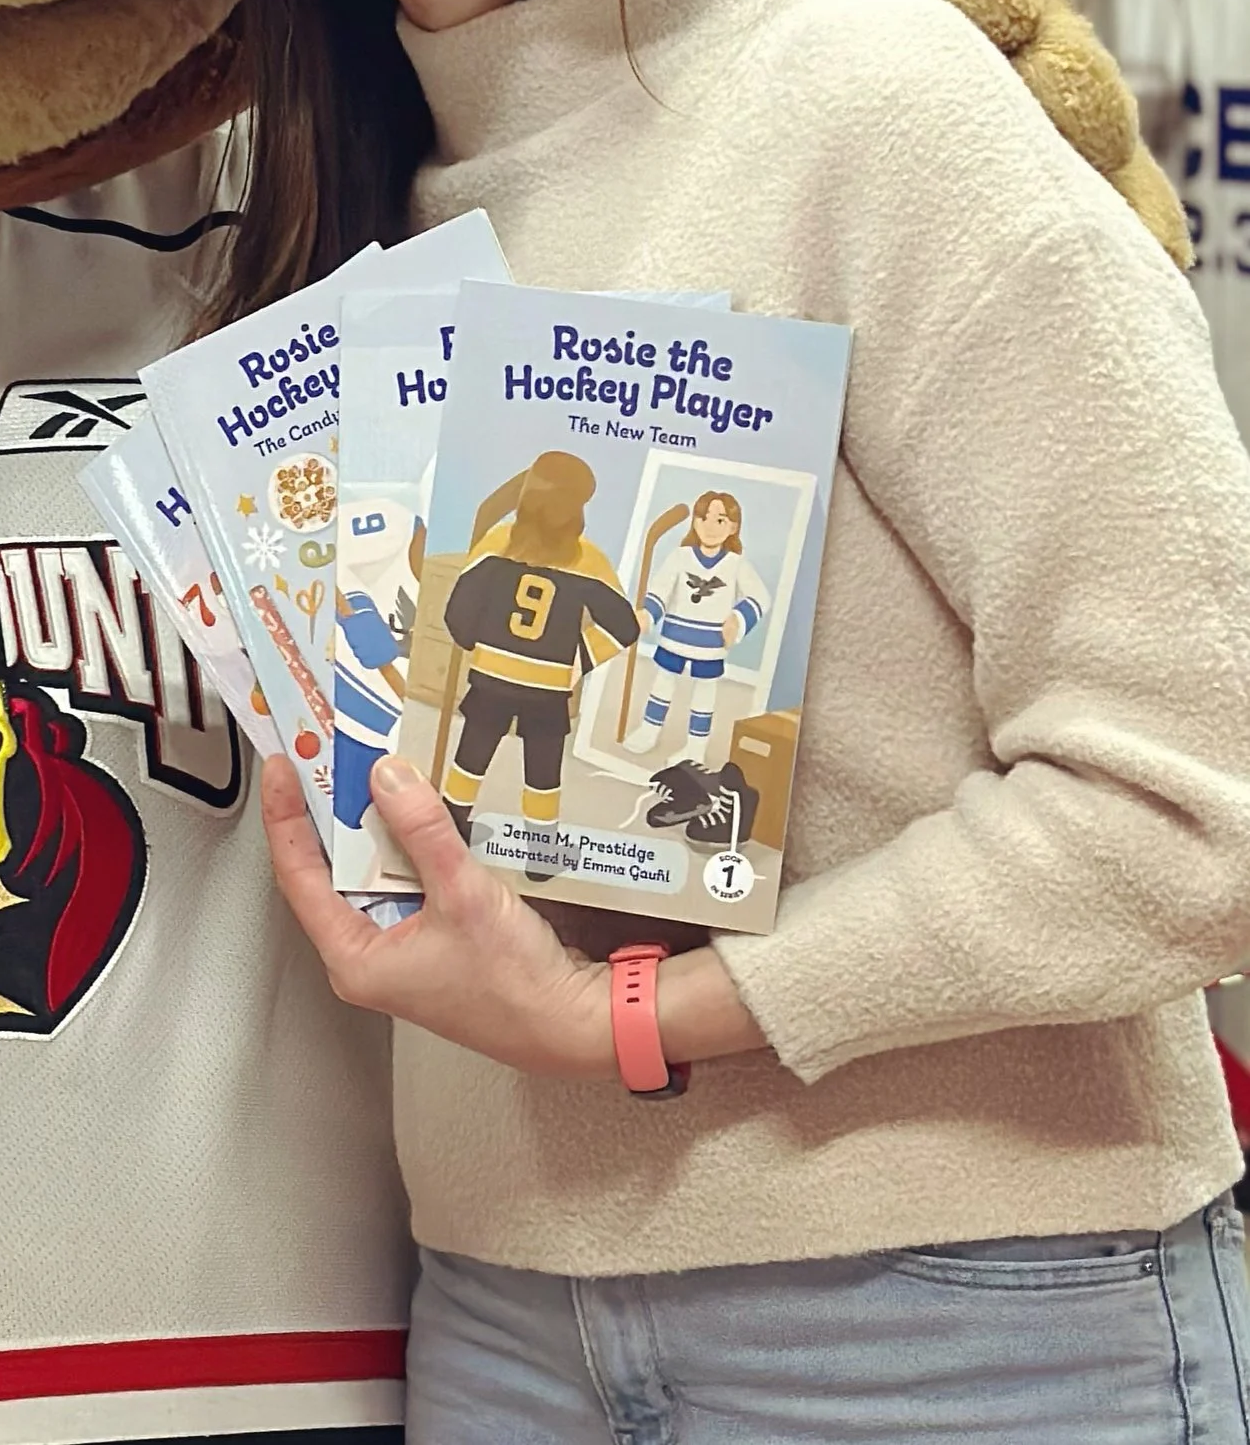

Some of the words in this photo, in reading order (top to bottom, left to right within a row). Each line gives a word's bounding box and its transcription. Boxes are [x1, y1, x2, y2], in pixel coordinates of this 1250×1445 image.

[238, 323, 340, 388] Rosie
[552, 324, 657, 368] Rosie
[667, 339, 733, 381] the
[217, 363, 340, 447] Hockey
[504, 364, 640, 417] Hockey
[650, 374, 773, 433] Player
[288, 408, 340, 442] Candy
[568, 415, 600, 435] The
[605, 421, 644, 441] New
[649, 425, 697, 448] Team
[253, 436, 287, 457] The
[509, 573, 557, 642] 9
[486, 841, 559, 865] Illustrated
[562, 853, 579, 871] by
[583, 857, 626, 876] Emma
[503, 823, 550, 844] Jenna
[579, 836, 655, 863] Prestidge
[721, 864, 735, 889] 1
